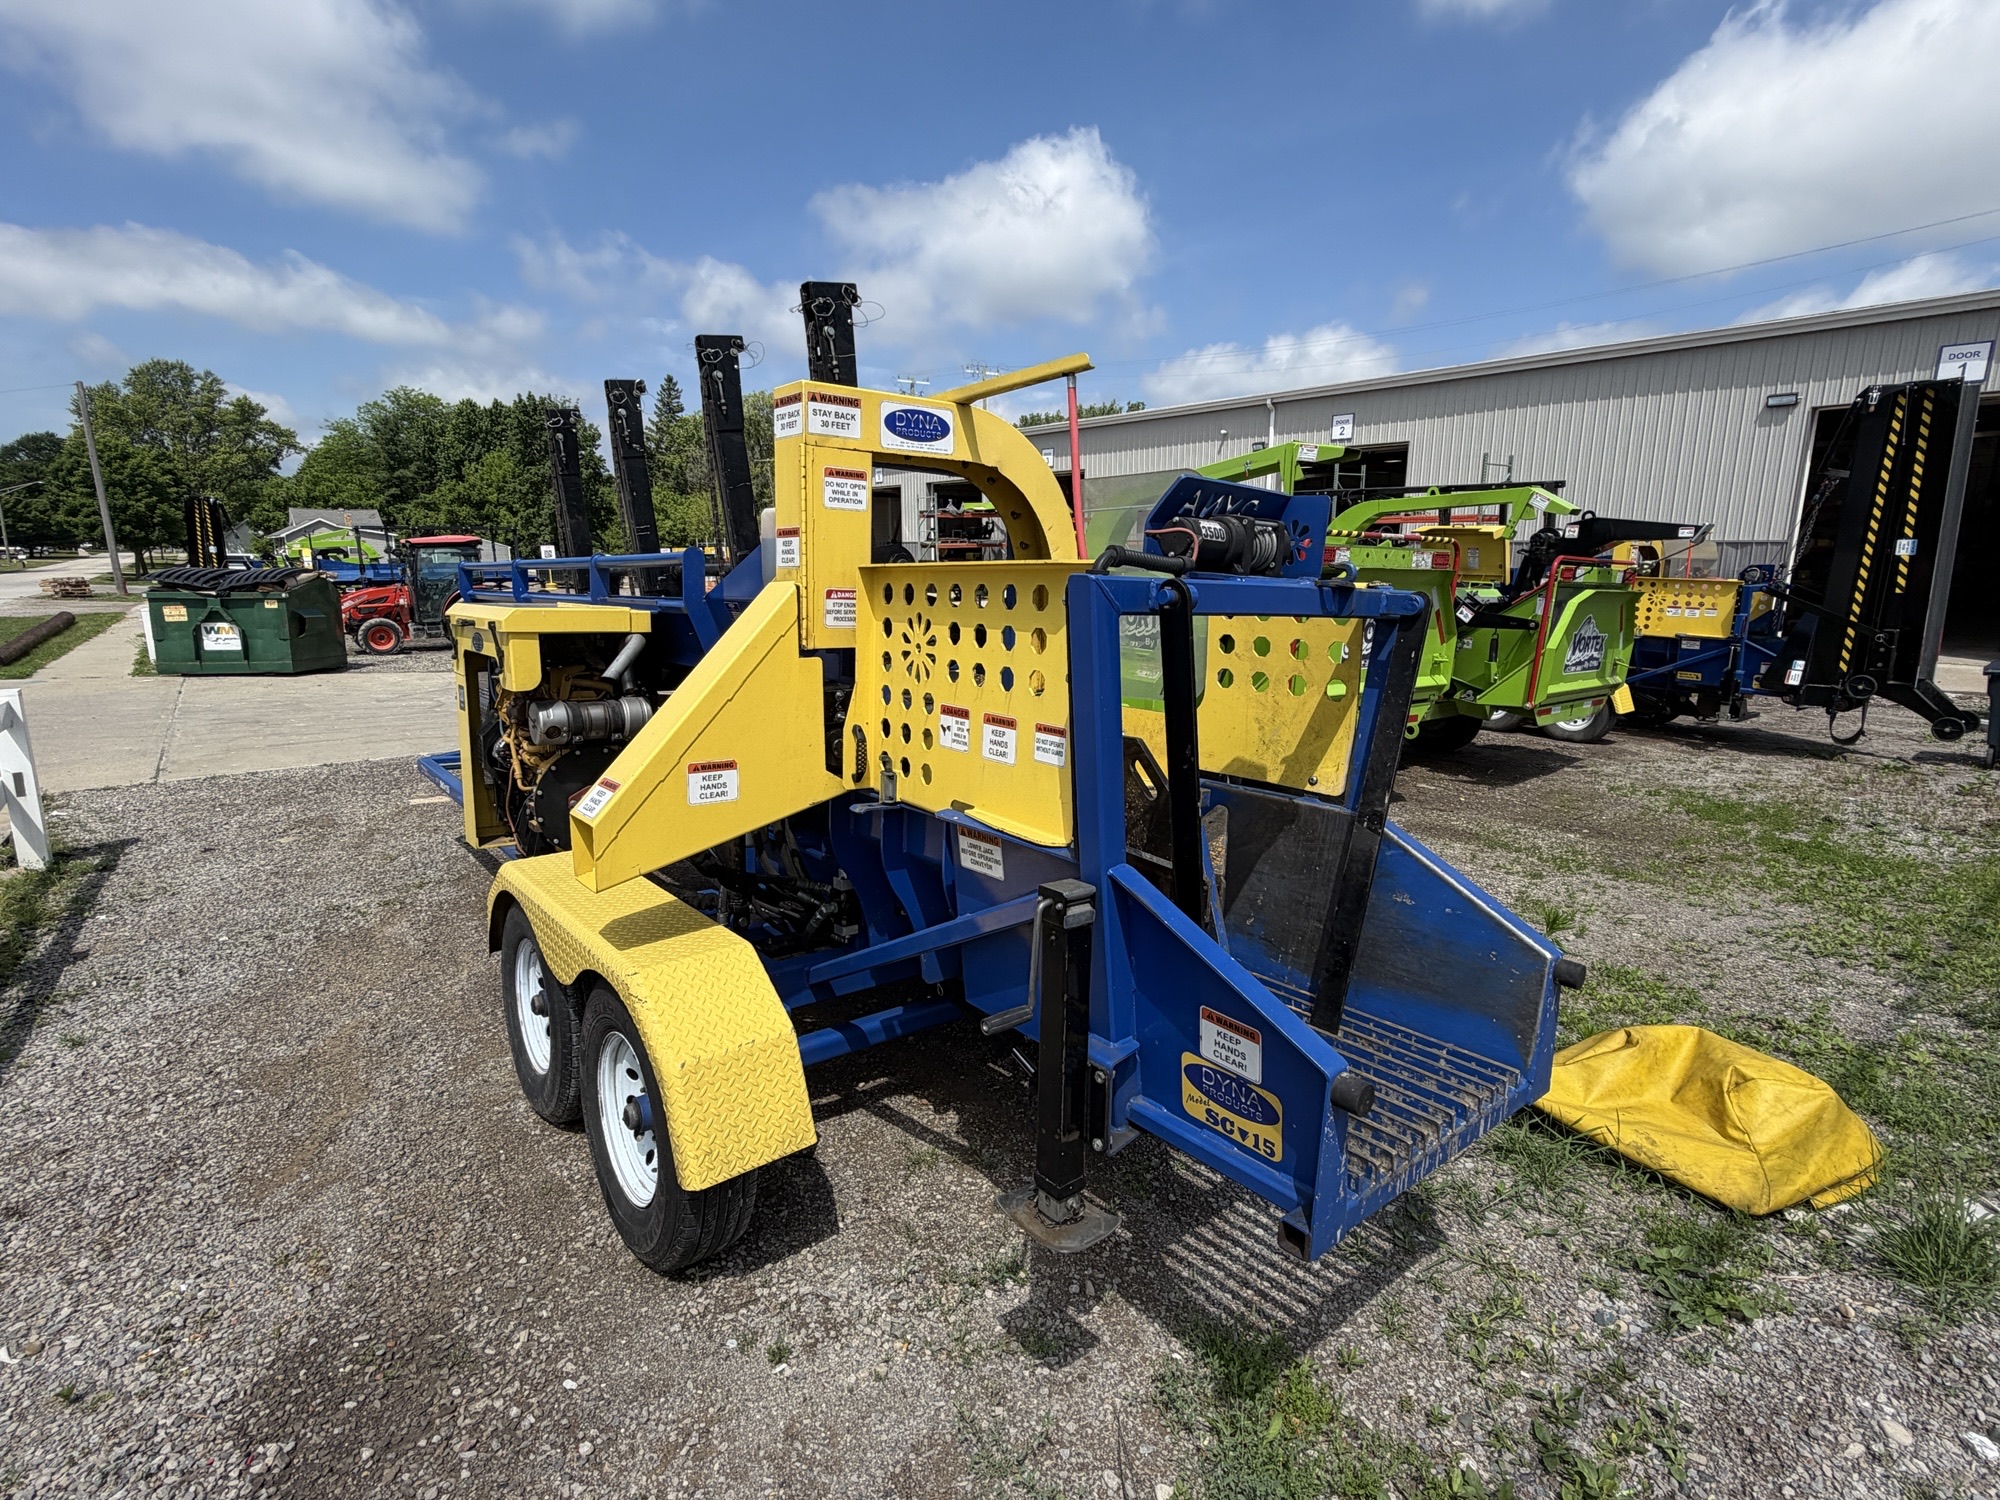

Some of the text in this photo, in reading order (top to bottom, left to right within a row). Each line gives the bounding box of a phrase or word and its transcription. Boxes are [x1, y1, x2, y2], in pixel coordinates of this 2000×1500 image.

[1949, 351, 1981, 360] DOOR
[1958, 362, 1967, 377] 1
[820, 393, 859, 407] WARNING
[776, 409, 800, 421] STAY BACK
[812, 409, 856, 421] STAY BACK
[780, 420, 797, 431] 30 FEET
[820, 420, 851, 430] 30 FEET
[895, 411, 942, 431] DYNA
[896, 427, 942, 440] PRODUCTS
[1339, 426, 1345, 436] 2
[835, 470, 864, 479] WARNING
[828, 497, 862, 505] OPERATION
[1202, 525, 1226, 541] 3500
[203, 626, 236, 635] WM
[1571, 634, 1607, 656] VORTEX
[947, 707, 968, 717] DANGER
[991, 717, 1014, 728] WARNING
[991, 728, 1006, 738] KEEP
[989, 738, 1008, 749] HANDS
[1048, 740, 1064, 749] OPERATE
[988, 748, 1008, 759] CLEAR!
[701, 762, 734, 770] WARNING
[702, 773, 723, 782] KEEP
[700, 782, 727, 791] HANDS
[699, 790, 728, 800] CLEAR!
[967, 829, 999, 846] WARNING
[966, 841, 982, 851] LOWER
[961, 848, 1001, 866] BEFORE OPERATING
[970, 858, 993, 871] CONVEYOR
[1215, 1015, 1256, 1040] WARNING
[1216, 1029, 1241, 1046] KEEP
[1214, 1039, 1247, 1061] HANDS
[1213, 1049, 1247, 1073] CLEAR!
[1202, 1066, 1262, 1112] DYNA
[1186, 1093, 1211, 1107] Model
[1202, 1084, 1263, 1122] PRODUCTS
